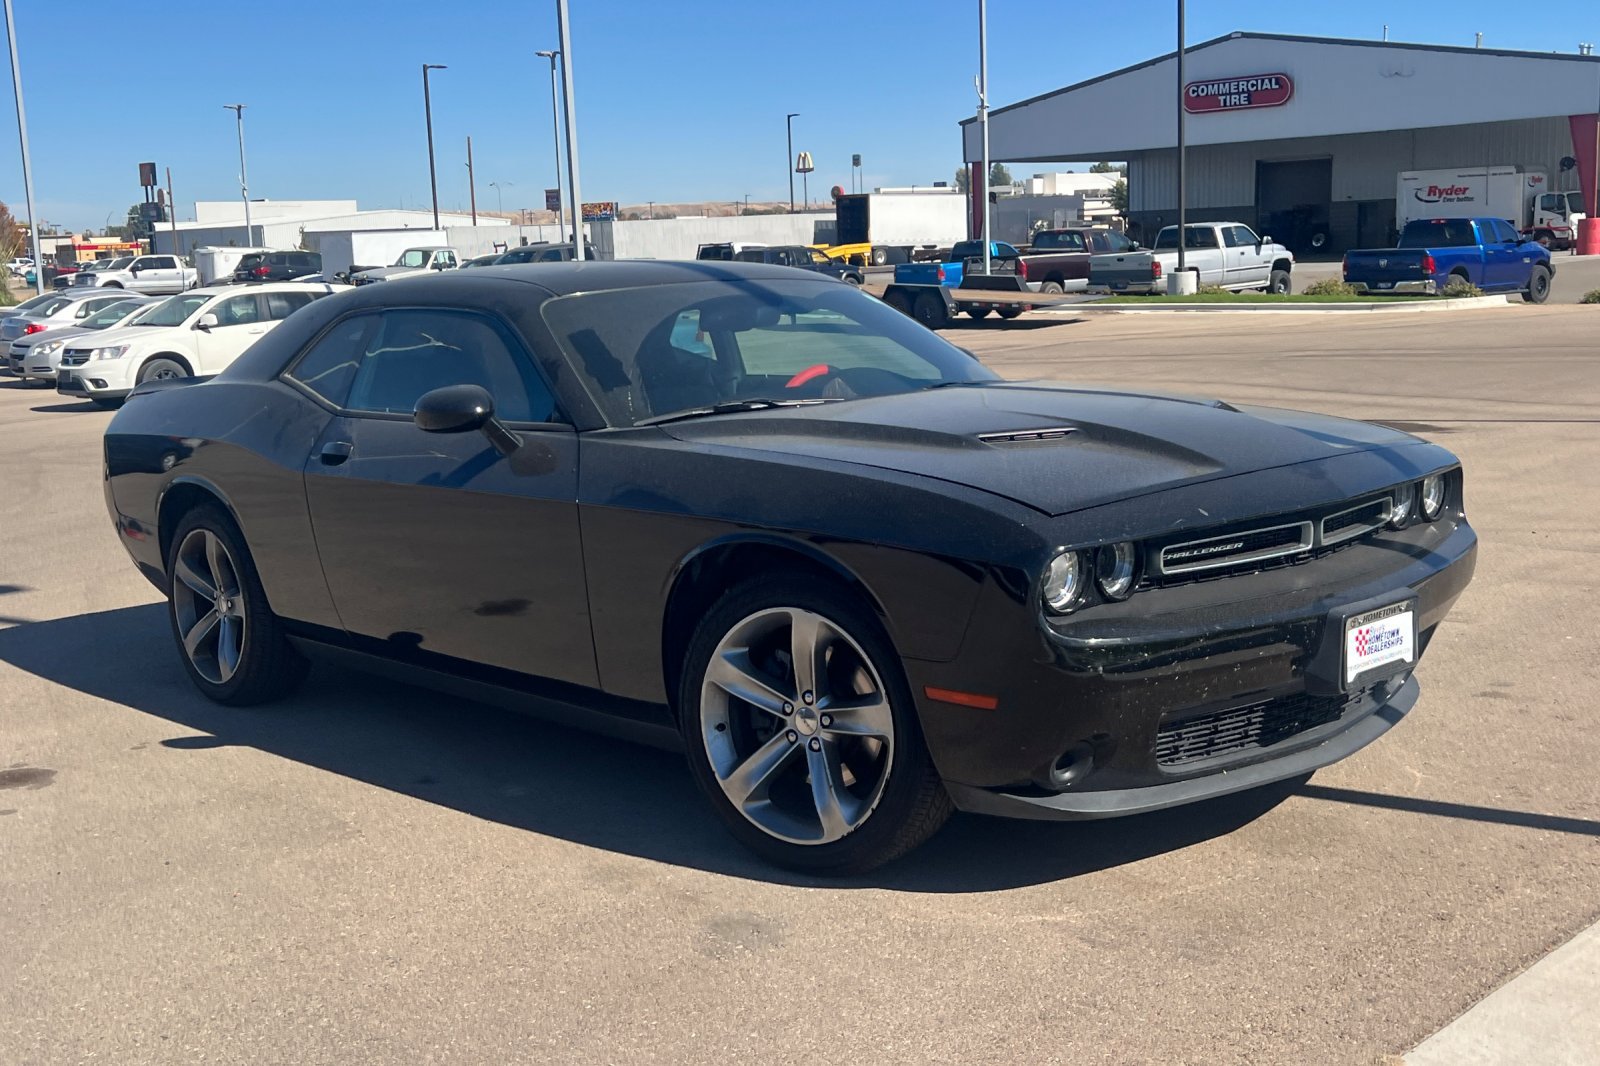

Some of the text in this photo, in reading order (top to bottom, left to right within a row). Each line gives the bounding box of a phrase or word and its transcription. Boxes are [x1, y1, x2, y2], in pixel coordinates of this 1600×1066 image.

[1188, 78, 1280, 97] COMMERCIAL
[1218, 94, 1249, 107] TIRE
[1427, 184, 1469, 198] Ryder
[1162, 542, 1243, 560] CHALLENGER
[1362, 604, 1405, 623] HOMETOWN
[1368, 628, 1400, 645] HOMETOWN
[1366, 636, 1403, 656] DEALERSHIPS
